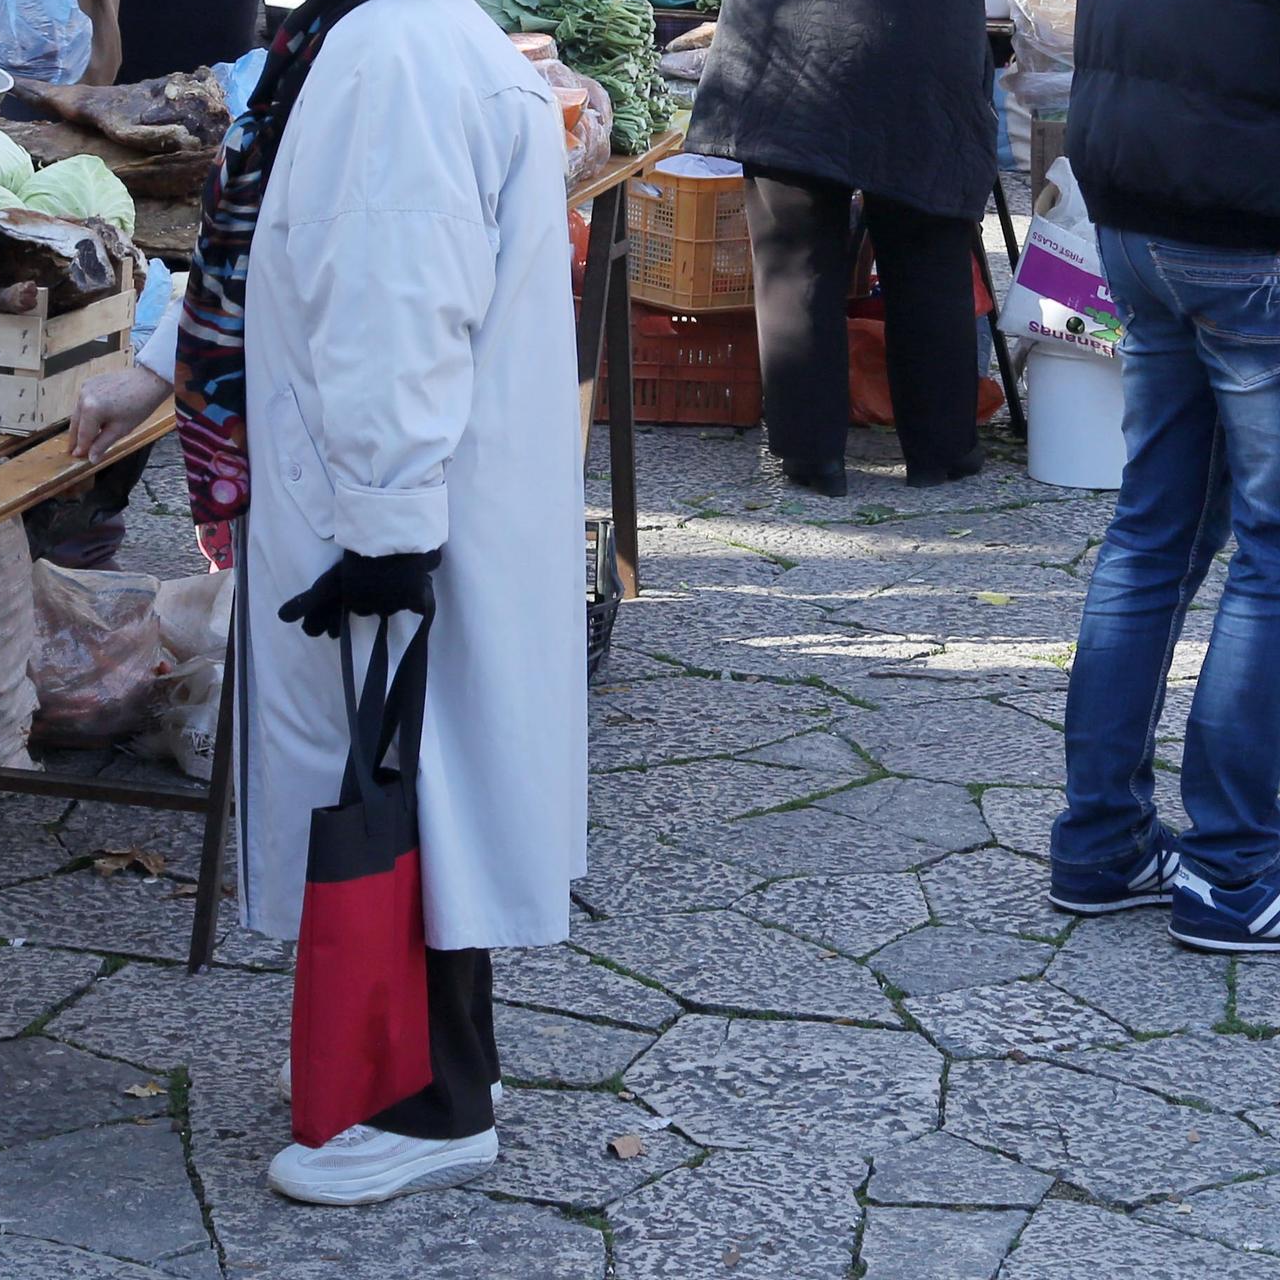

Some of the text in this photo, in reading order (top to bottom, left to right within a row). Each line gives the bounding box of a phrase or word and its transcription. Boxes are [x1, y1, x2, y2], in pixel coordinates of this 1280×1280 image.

[1032, 231, 1085, 264] FIRST CLASS
[1029, 320, 1115, 359] Bananas
